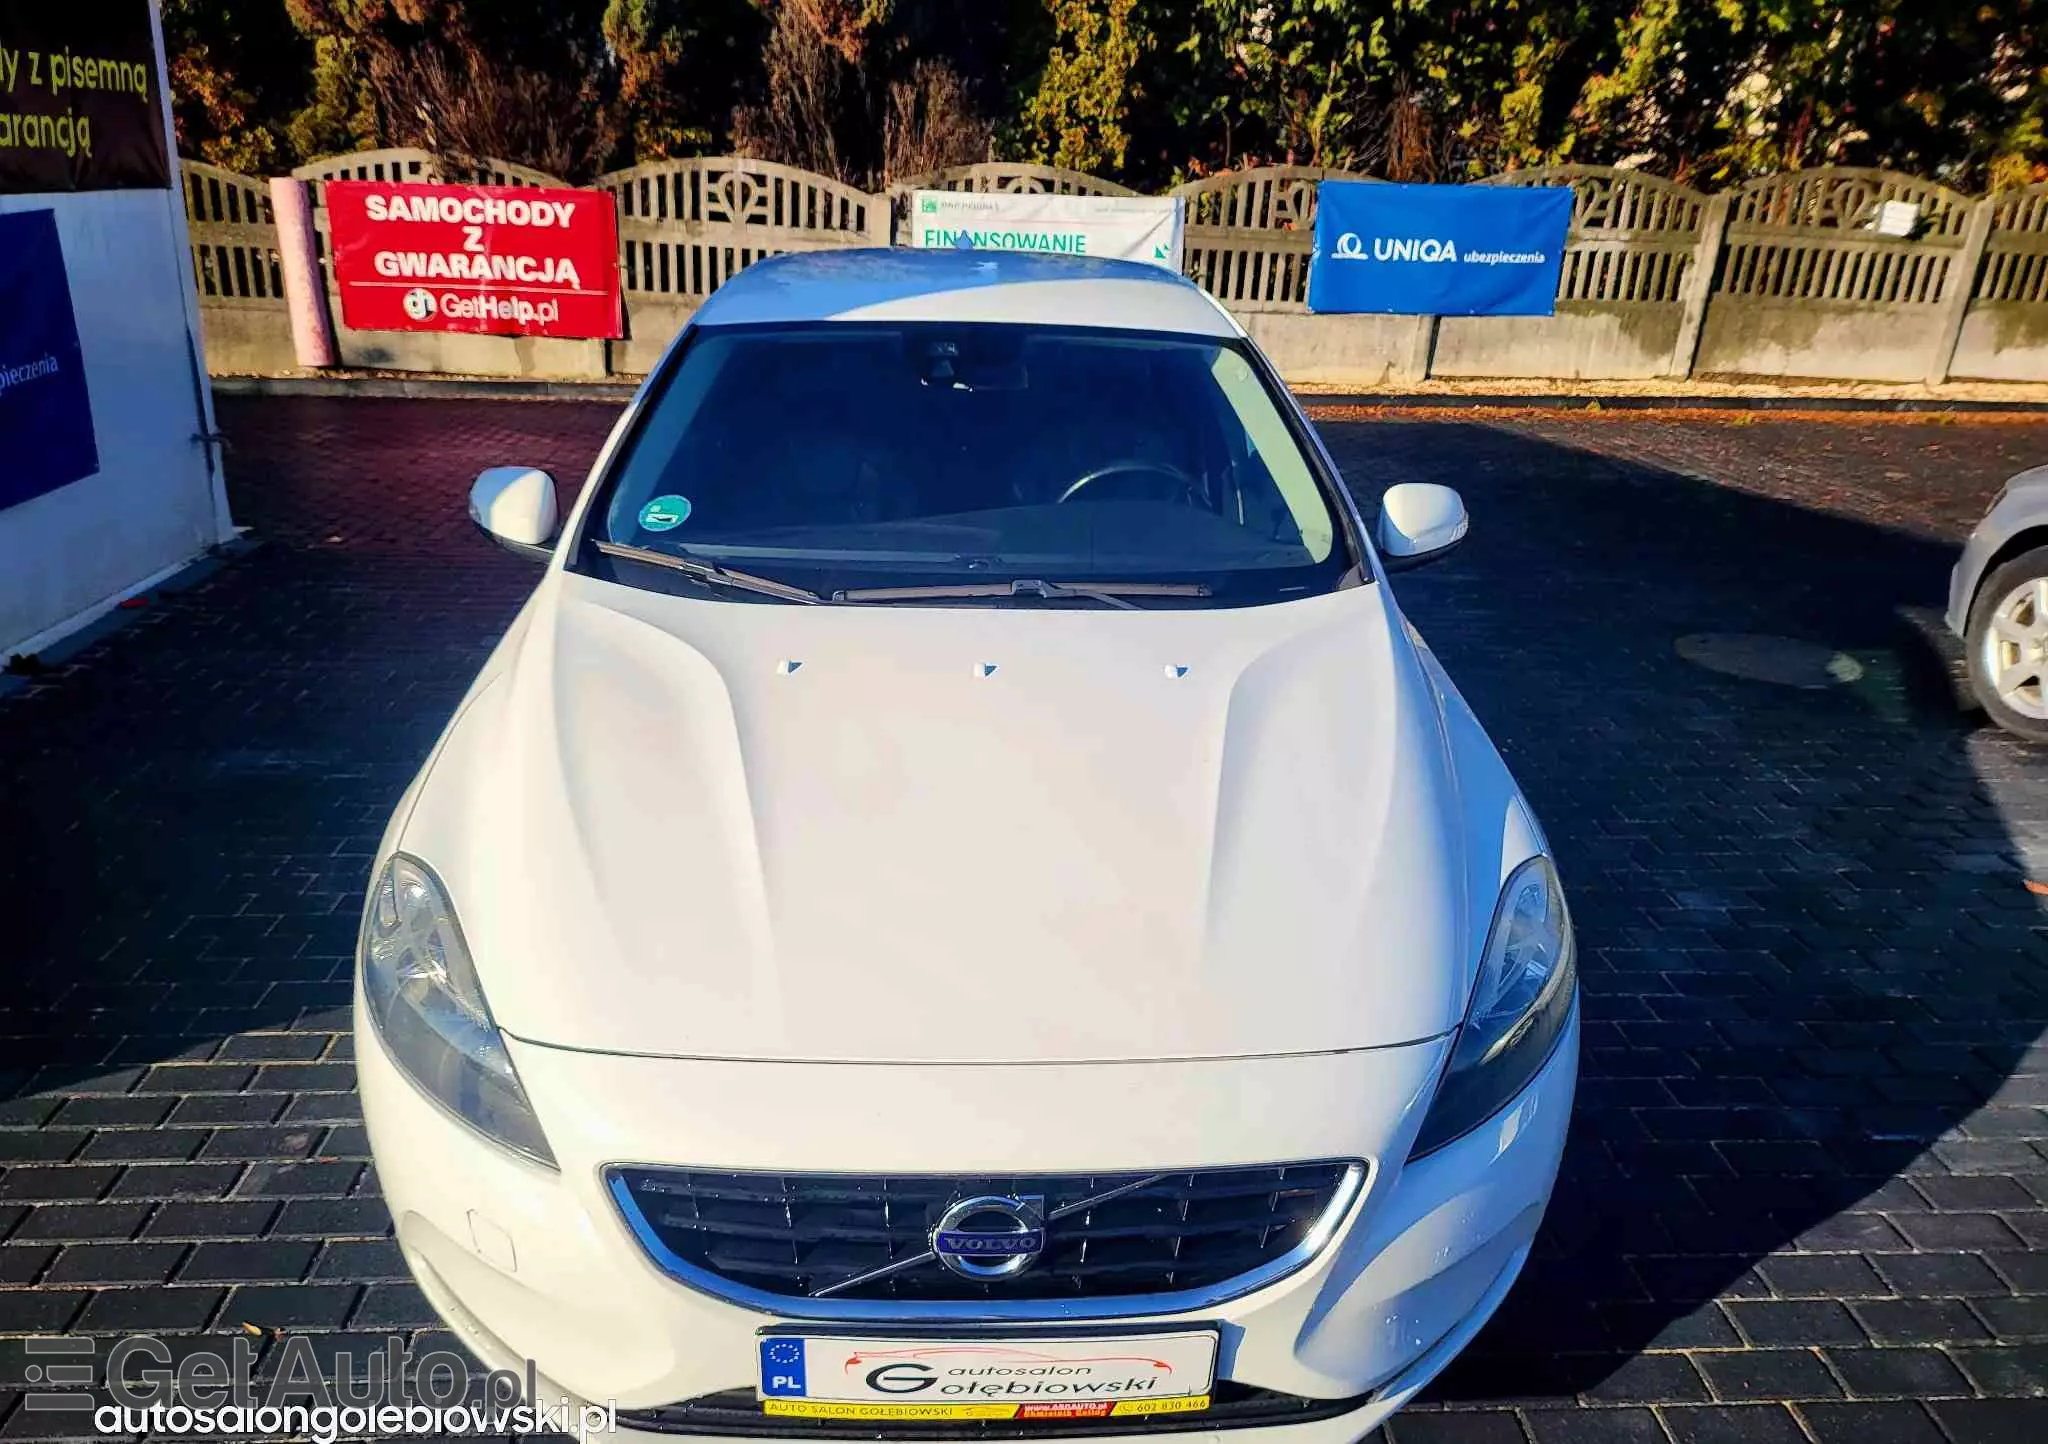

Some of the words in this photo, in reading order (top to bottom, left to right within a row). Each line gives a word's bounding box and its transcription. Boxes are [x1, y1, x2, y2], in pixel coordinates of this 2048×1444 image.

[28, 51, 42, 85] z
[50, 45, 148, 103] pisemną
[0, 107, 92, 158] arancją
[365, 194, 576, 228] SAMOCHODY
[462, 225, 485, 252] Z
[924, 229, 1087, 255] FINANSOWANIE
[1374, 237, 1457, 263] UNIQA
[1463, 250, 1546, 266] ubezpieczenia
[374, 252, 581, 290] GWARANCJĄ
[440, 293, 559, 326] GetHelp.pl
[944, 1236, 1037, 1250] VOLVO
[771, 1376, 802, 1389] PL
[947, 1365, 1092, 1377] autosalon
[769, 1402, 807, 1413] AUTO
[812, 1405, 855, 1415] SALON
